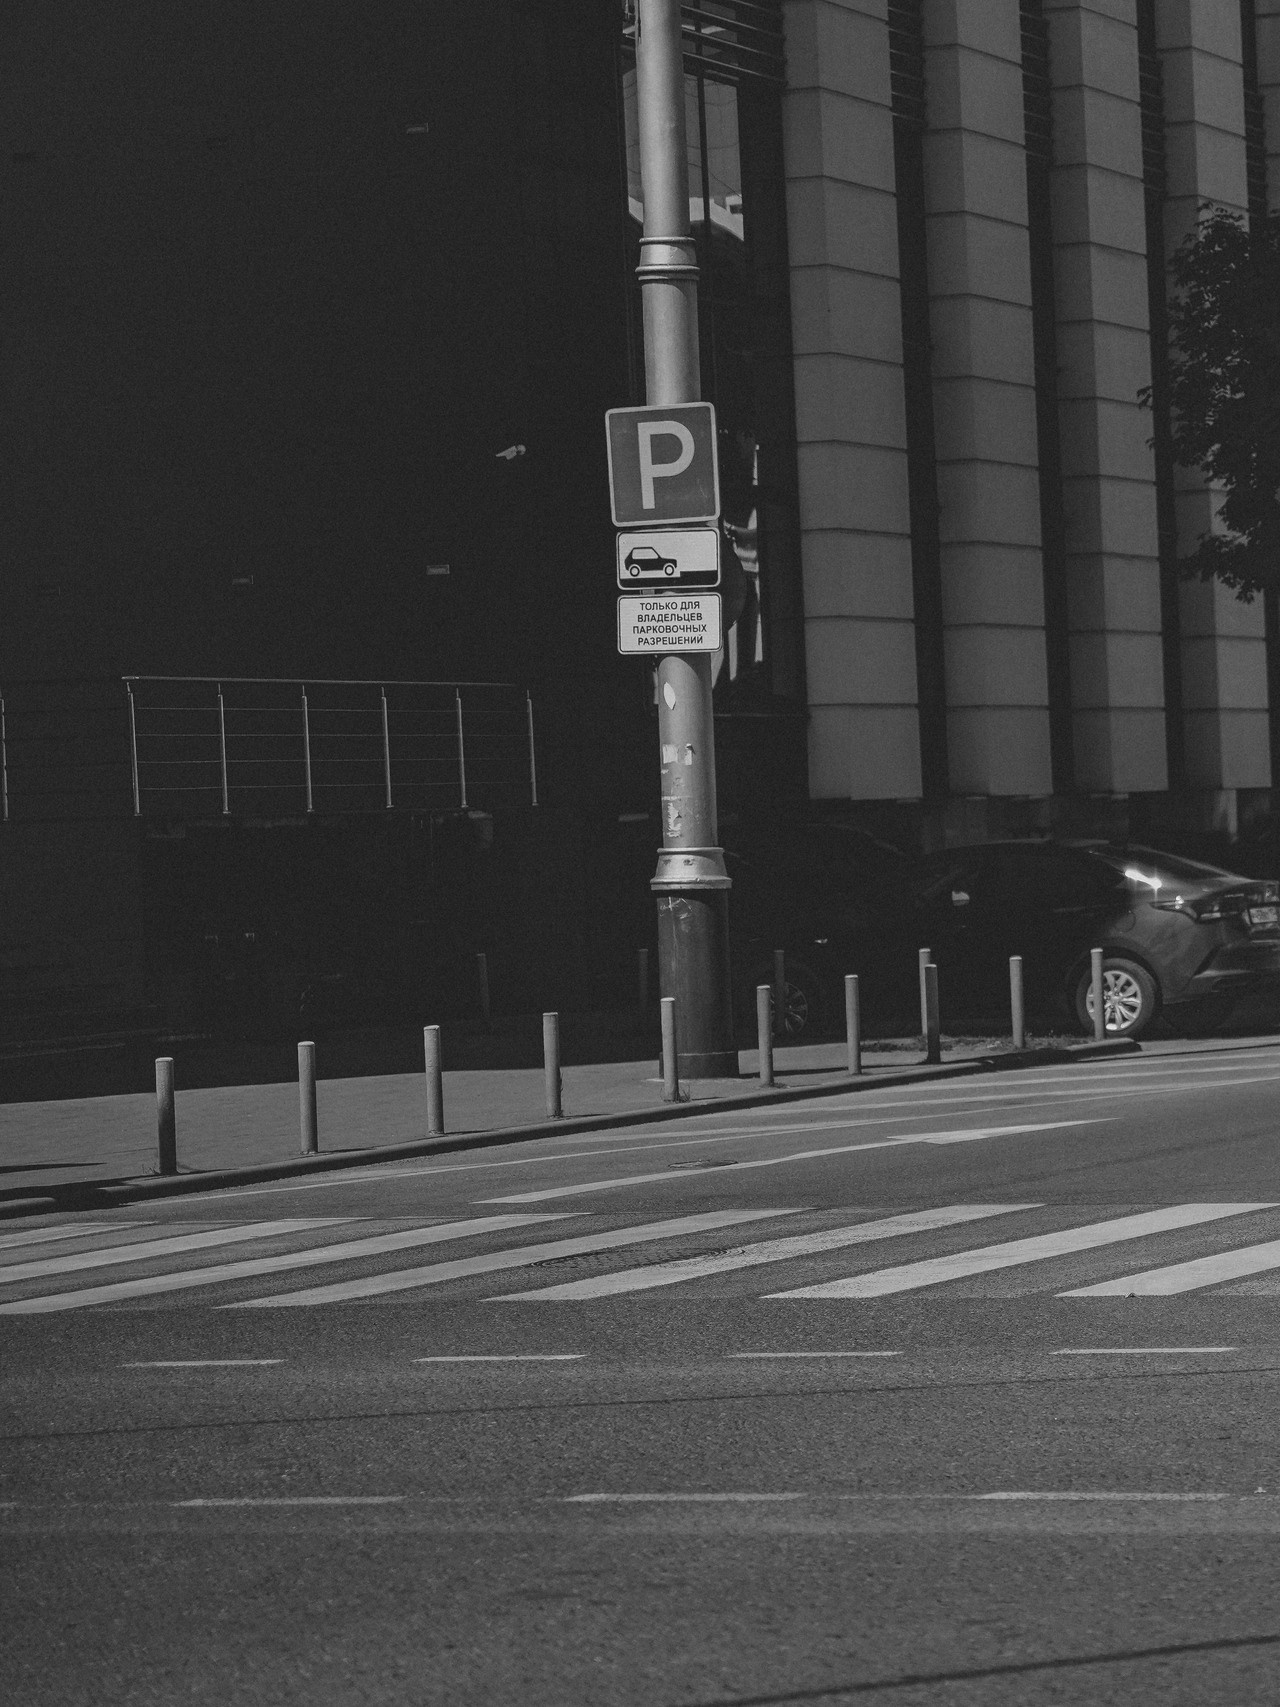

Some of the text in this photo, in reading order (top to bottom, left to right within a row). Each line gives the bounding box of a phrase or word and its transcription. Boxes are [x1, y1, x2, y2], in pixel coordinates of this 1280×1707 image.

[638, 420, 695, 509] P
[640, 601, 700, 611] ТОЛЬКО ДЛЯ
[638, 613, 702, 622] ВЛАДЕЛЬЦЕВ
[633, 625, 707, 634] ПАРКОВОЧНЫХ
[638, 635, 703, 645] РАЗРЕШЕНИЙ
